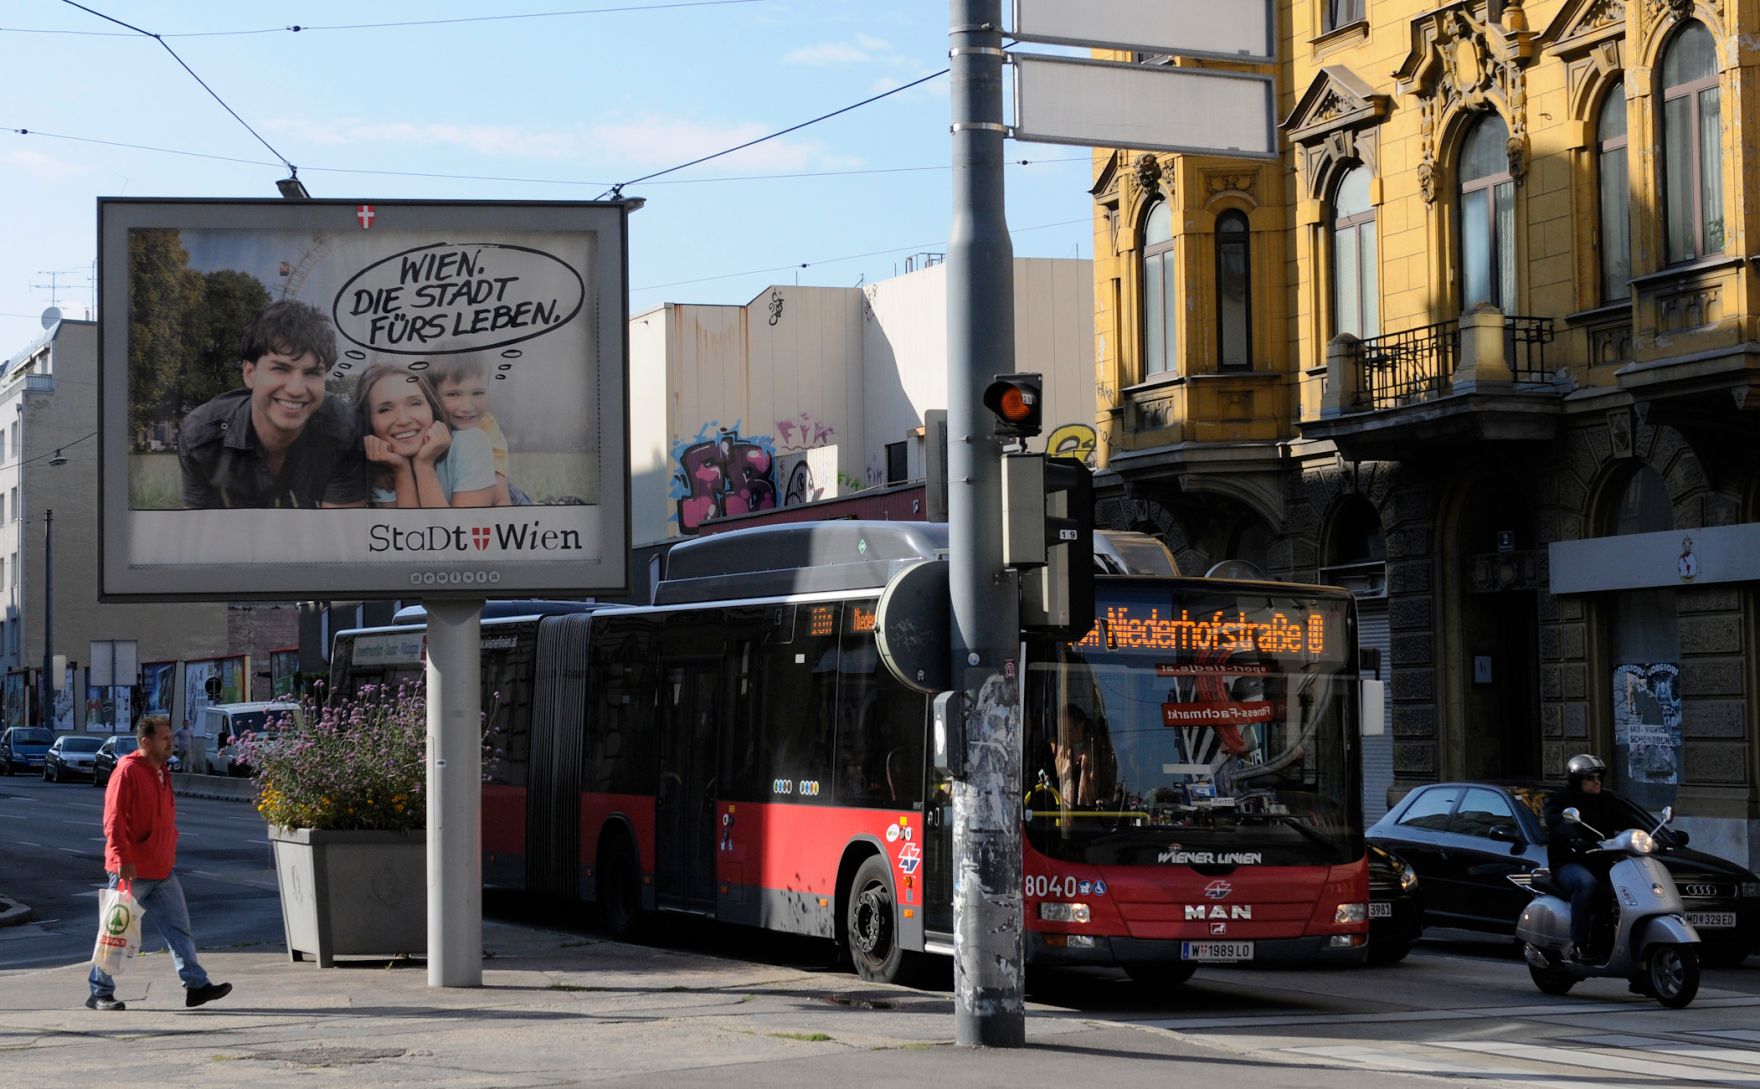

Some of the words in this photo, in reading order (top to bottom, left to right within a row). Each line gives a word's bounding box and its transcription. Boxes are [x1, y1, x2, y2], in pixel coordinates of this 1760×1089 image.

[400, 249, 485, 285] WIEN.
[350, 286, 404, 316] DIE
[410, 276, 519, 308] STADT
[369, 313, 448, 345] FÜRS
[452, 298, 561, 337] LEBEN.
[495, 520, 582, 550] Wien
[1061, 530, 1076, 539] 19
[1107, 607, 1301, 653] Niederhofstraße
[1158, 852, 1215, 864] WIENER
[1217, 852, 1262, 865] LINIEN
[1025, 875, 1077, 898] 8040
[1184, 905, 1252, 920] MAN
